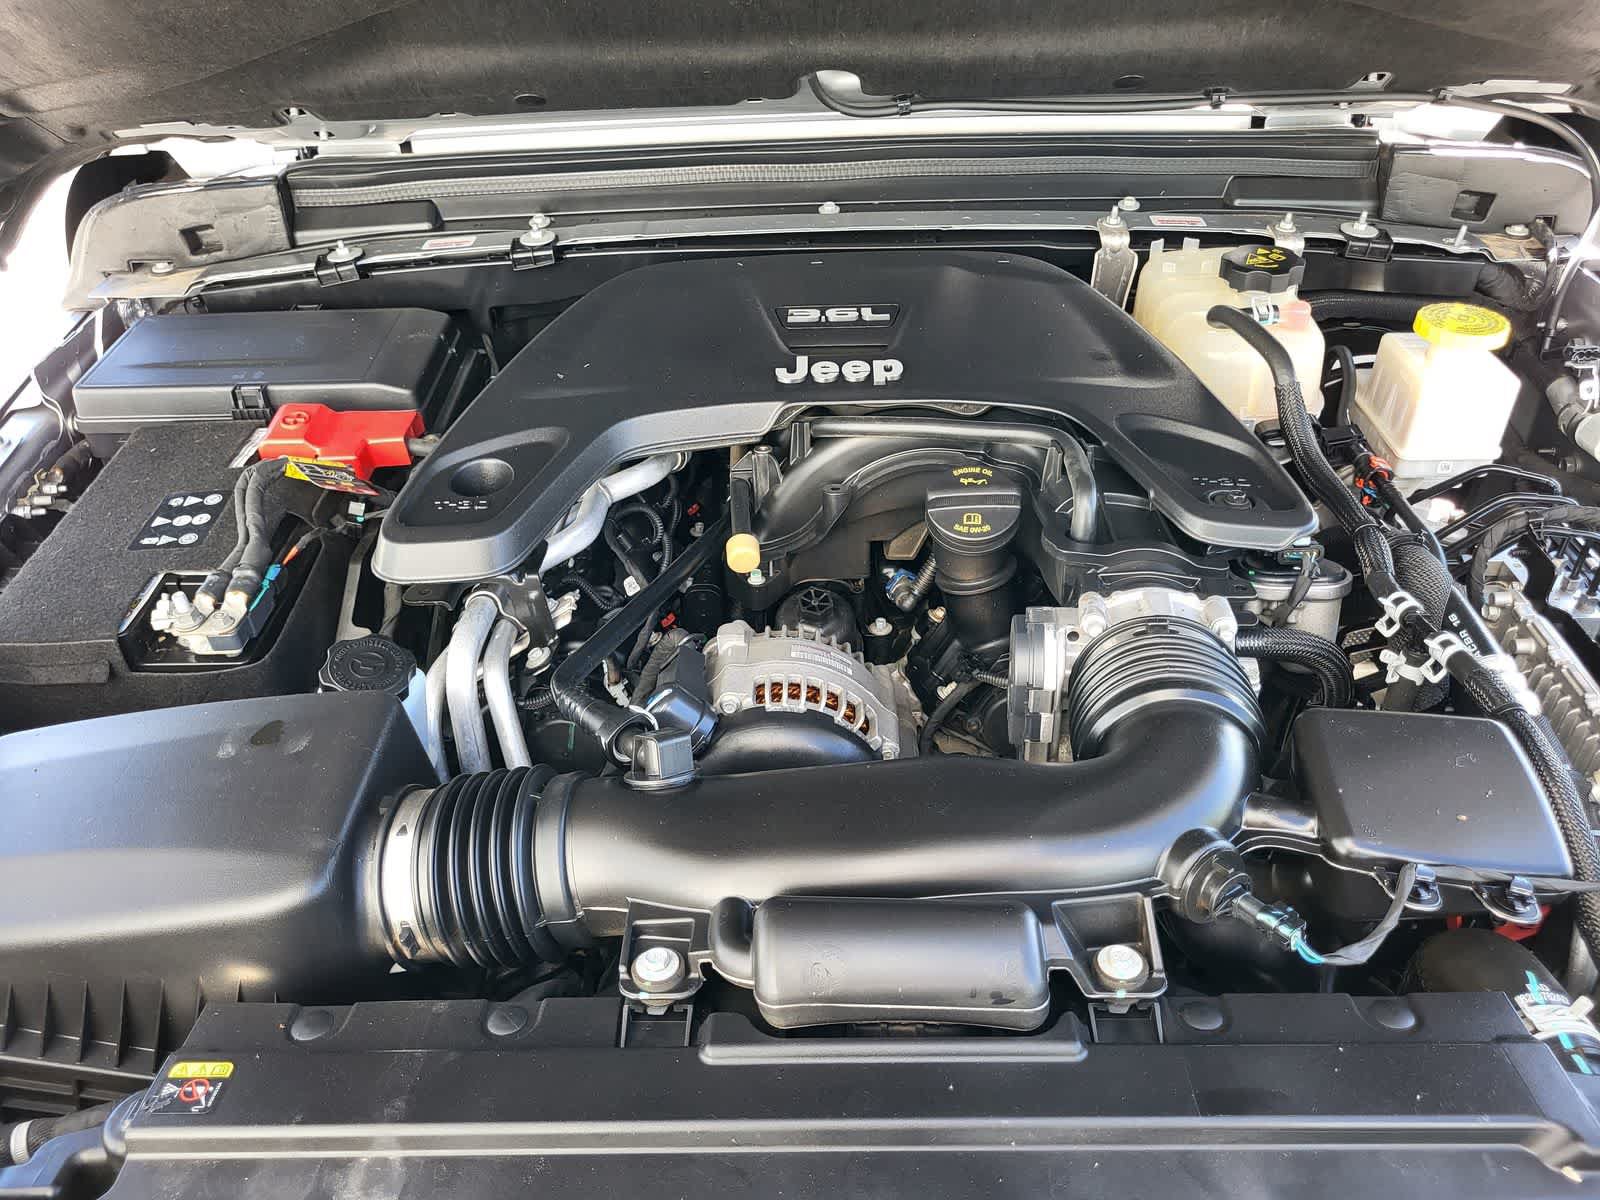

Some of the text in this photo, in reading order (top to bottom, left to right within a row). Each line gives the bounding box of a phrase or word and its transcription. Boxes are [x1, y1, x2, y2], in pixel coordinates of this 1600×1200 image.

[786, 307, 890, 323] 3.6L
[775, 356, 904, 386] Jeep
[953, 467, 993, 477] ENGINE OIL
[953, 523, 968, 533] SAE
